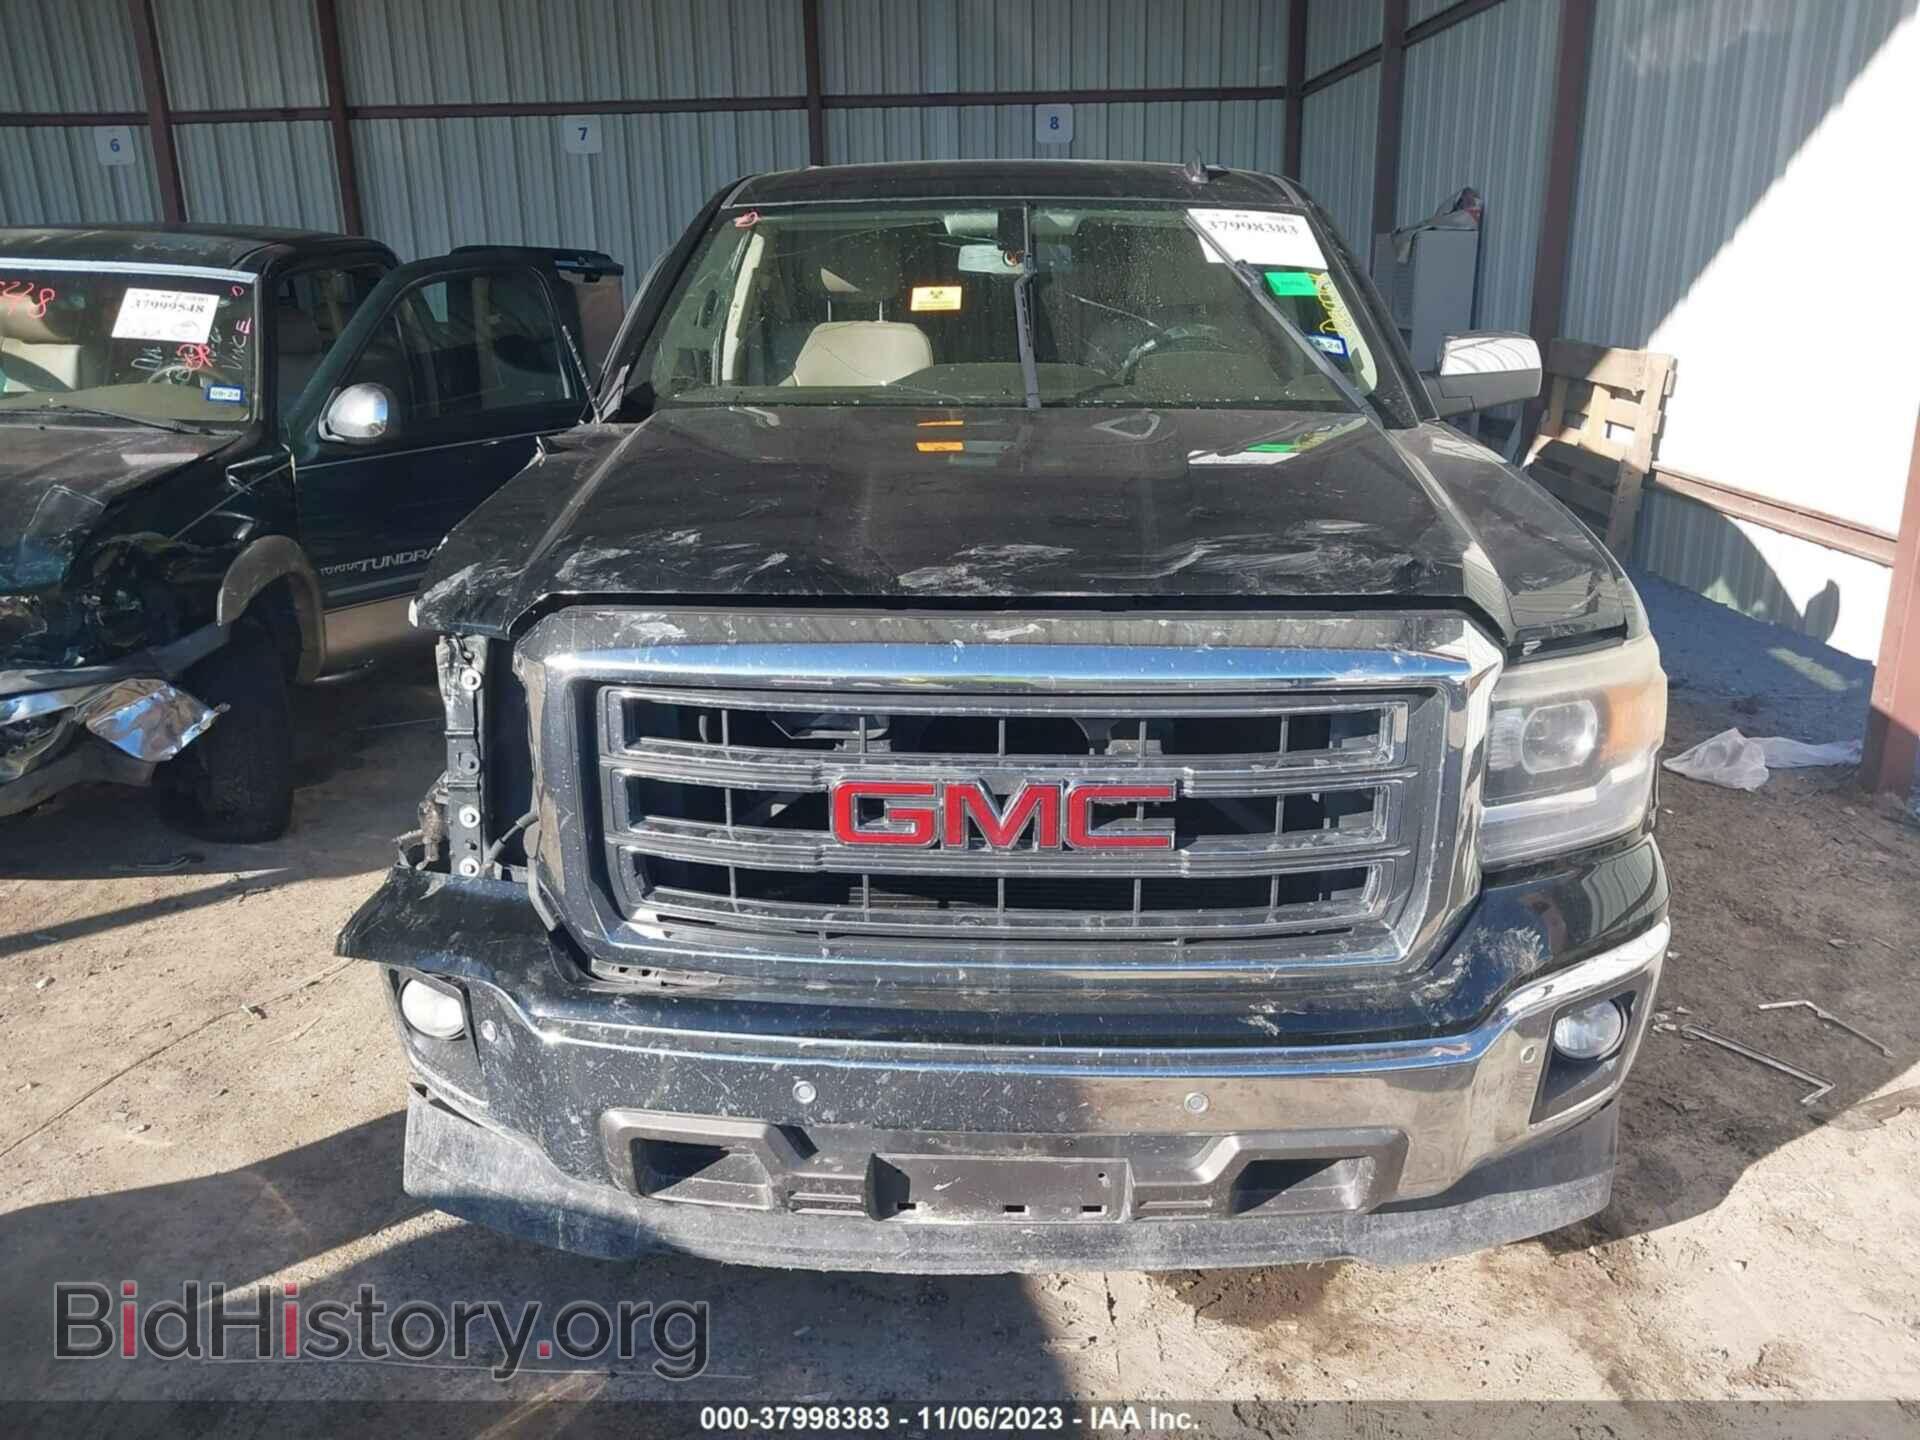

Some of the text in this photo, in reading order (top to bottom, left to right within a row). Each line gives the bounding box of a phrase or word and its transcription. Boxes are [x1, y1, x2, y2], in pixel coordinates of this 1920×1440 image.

[1050, 116, 1060, 130] 8
[578, 127, 588, 141] 7
[110, 138, 120, 152] 6
[829, 780, 1176, 851] GMC
